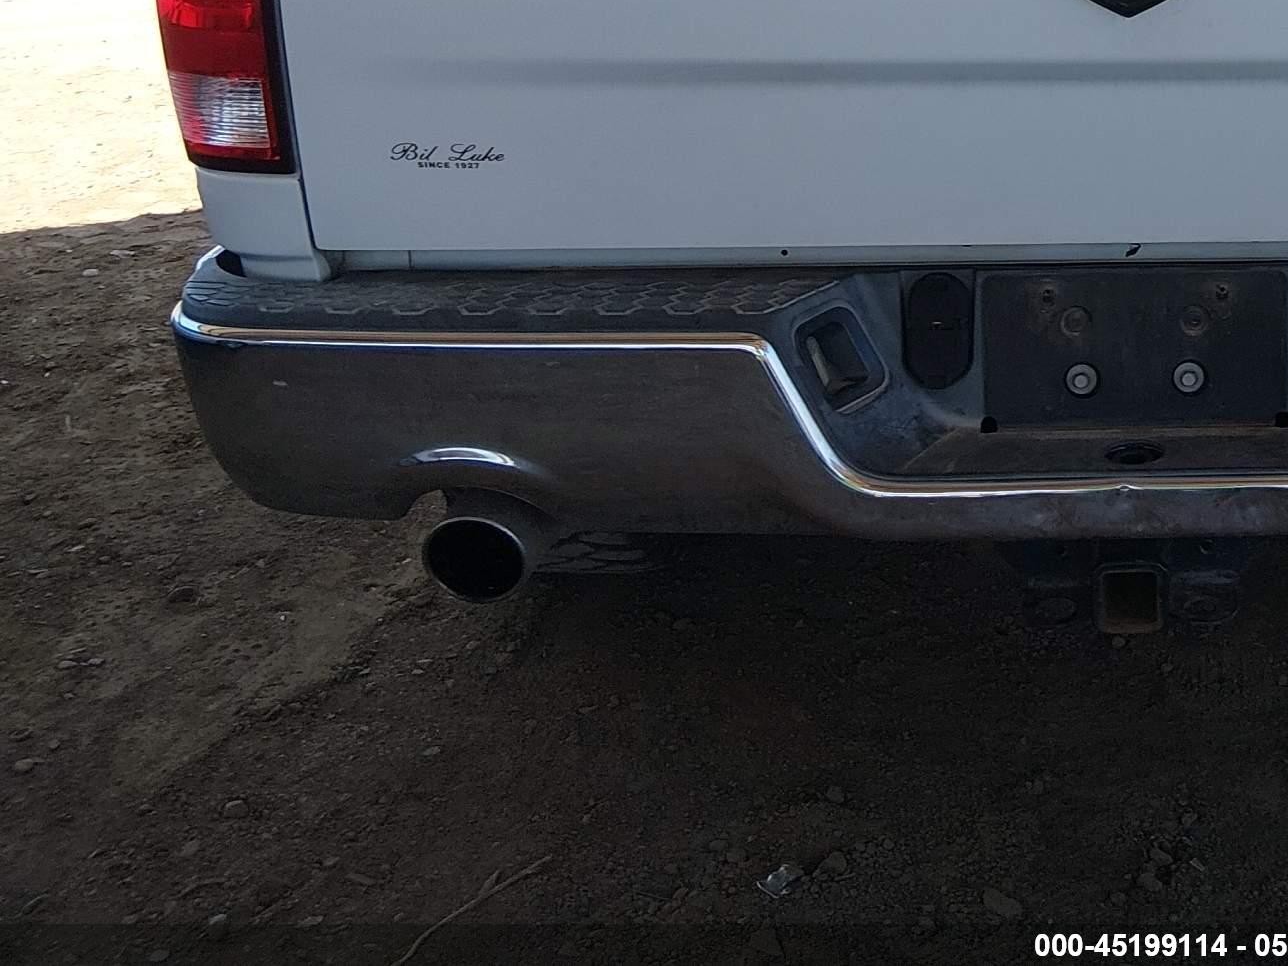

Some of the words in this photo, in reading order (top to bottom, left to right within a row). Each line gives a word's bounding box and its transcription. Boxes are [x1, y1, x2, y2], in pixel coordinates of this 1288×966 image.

[390, 142, 439, 161] Bil
[448, 143, 505, 162] Luke
[417, 161, 450, 169] SINCE
